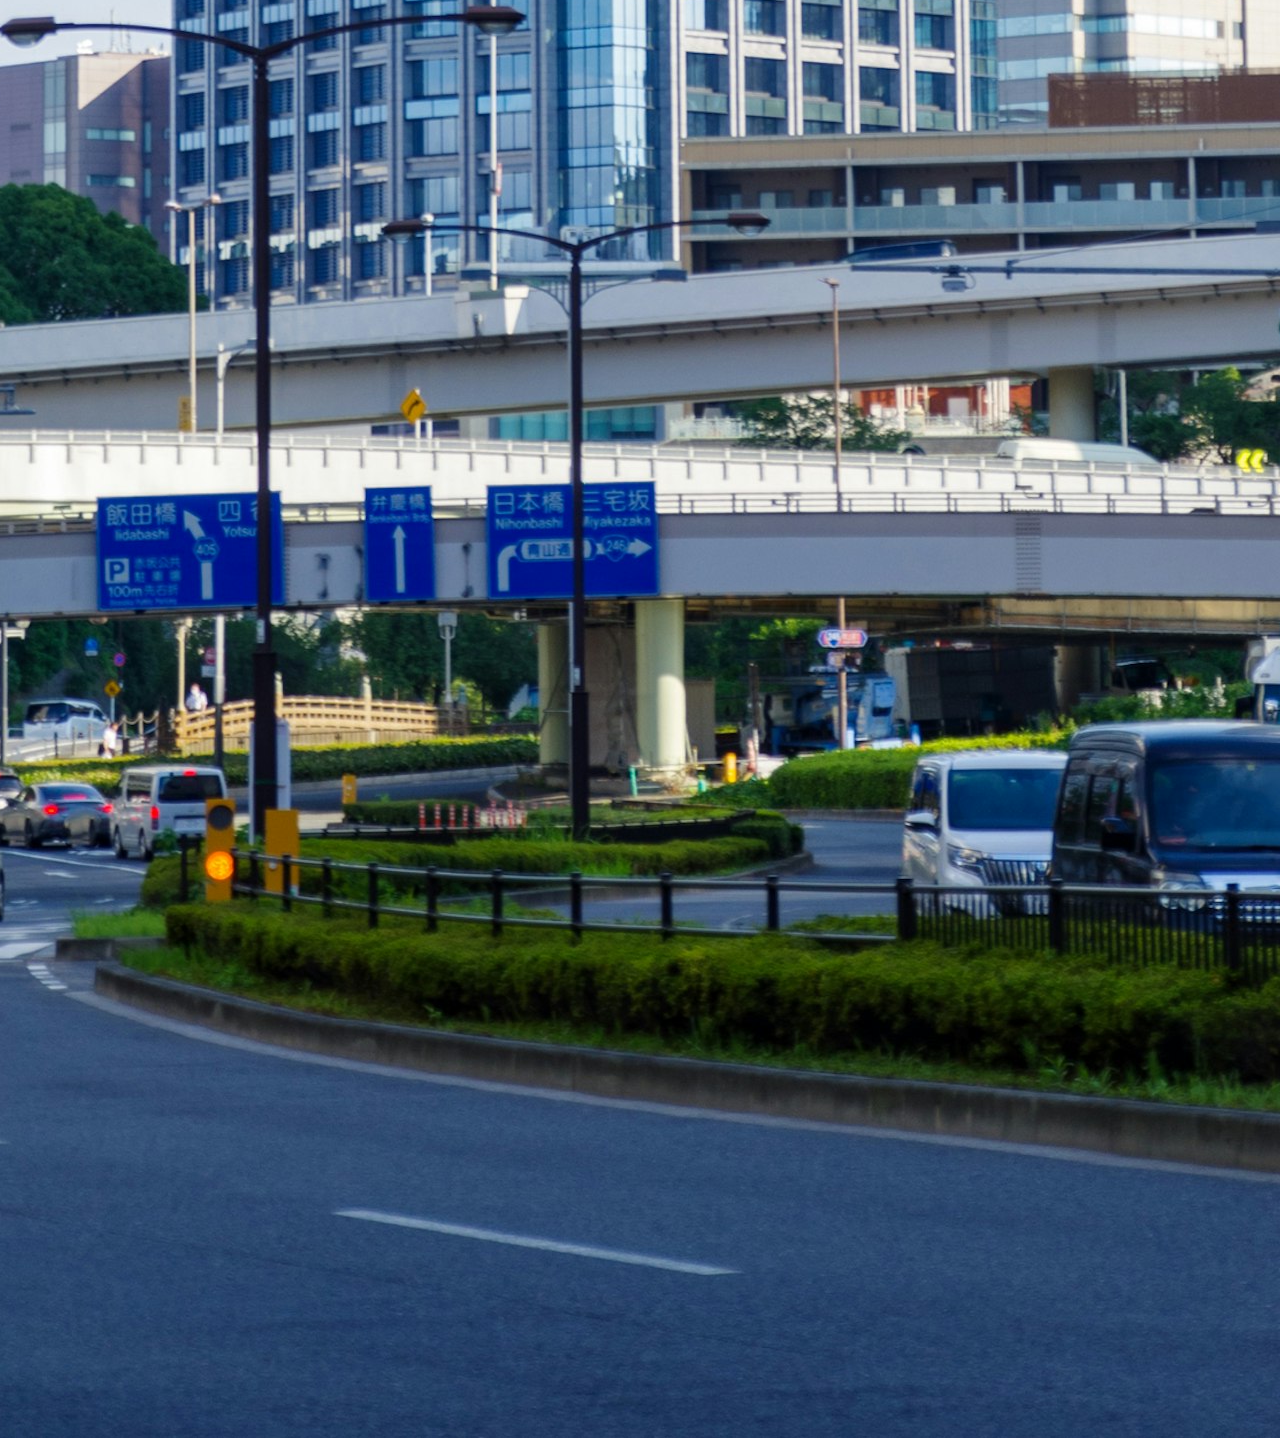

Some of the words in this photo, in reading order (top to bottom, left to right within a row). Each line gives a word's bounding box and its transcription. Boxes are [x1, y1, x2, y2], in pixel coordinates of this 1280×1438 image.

[495, 491, 565, 515] 日本橋
[582, 489, 651, 512] 三宅坂
[106, 502, 177, 526] 飯田橋
[496, 516, 564, 530] Nihonbashi
[115, 528, 170, 541] Iidabashi
[196, 544, 218, 556] 405
[607, 539, 625, 553] 246
